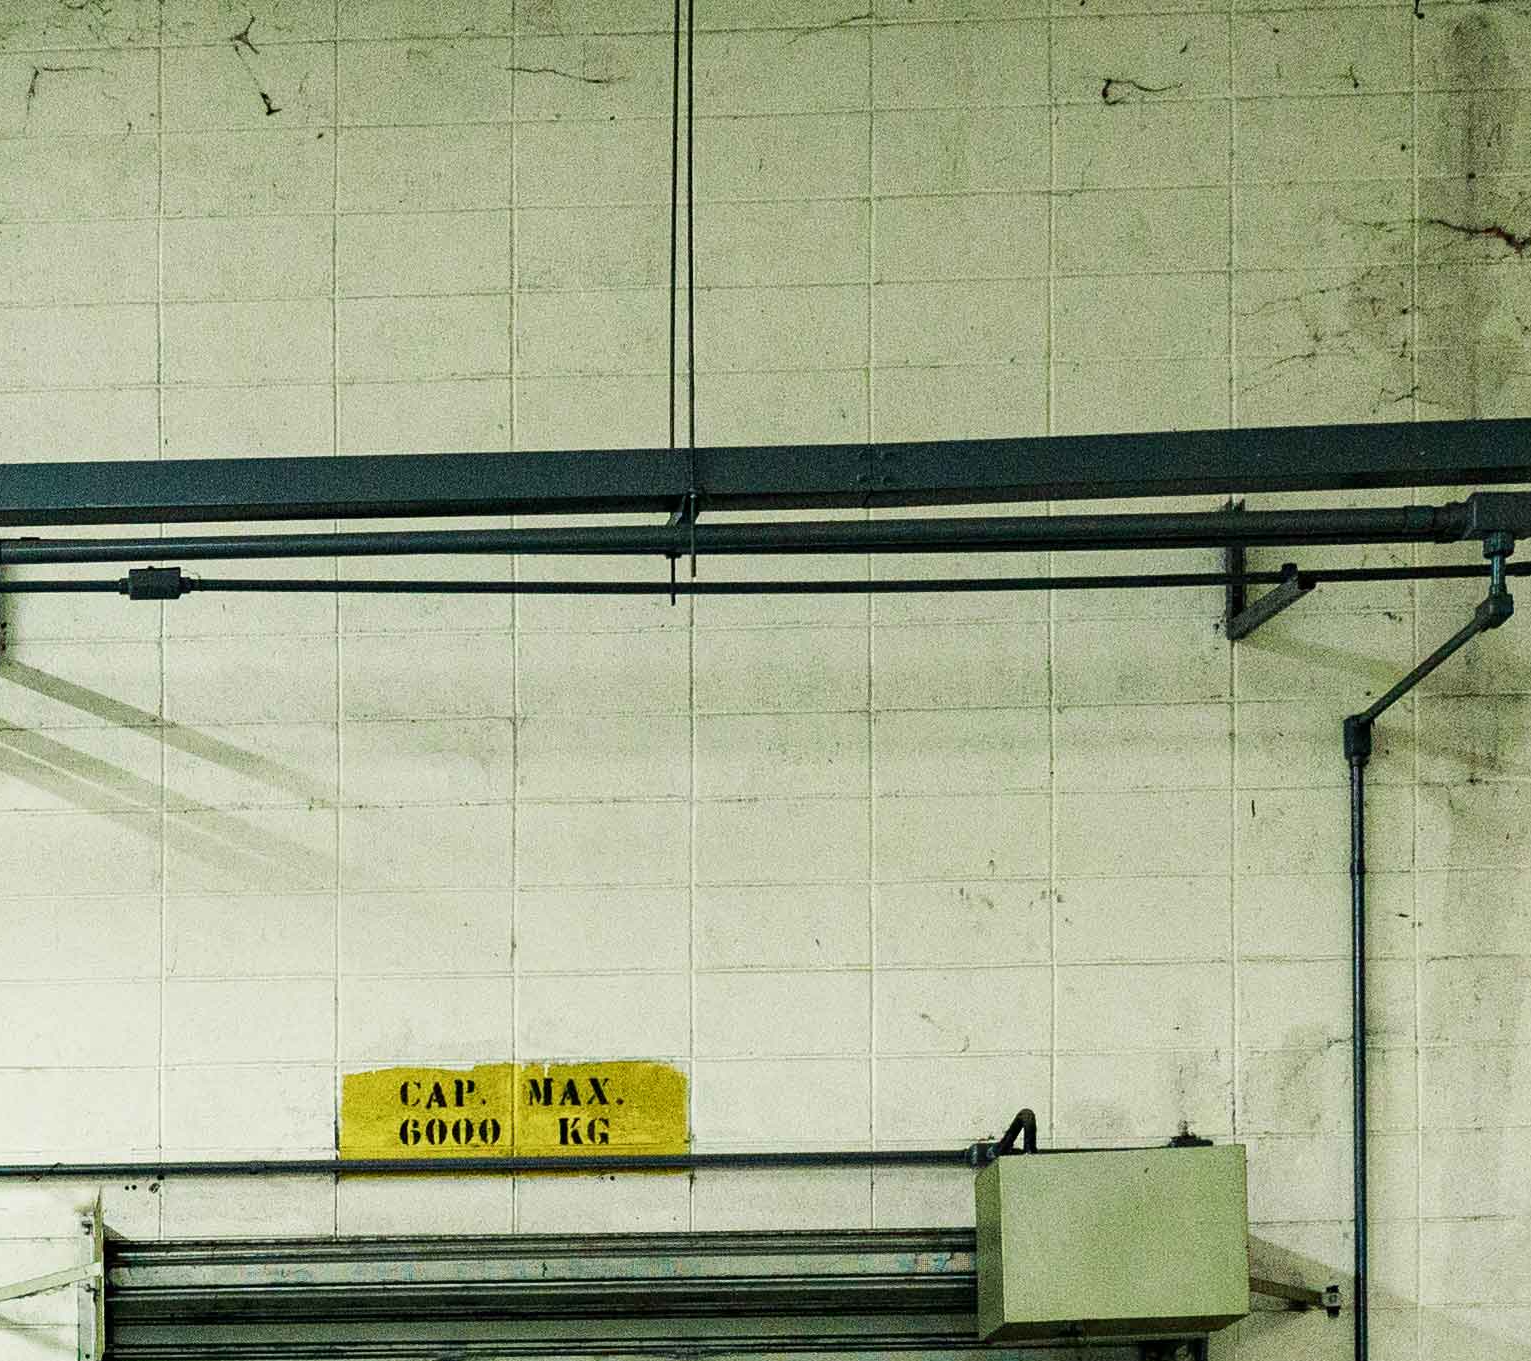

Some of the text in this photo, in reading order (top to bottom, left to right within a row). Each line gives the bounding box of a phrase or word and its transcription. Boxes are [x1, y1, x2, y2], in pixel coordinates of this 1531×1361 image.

[399, 1078, 626, 1108] CAP. MAX.
[399, 1117, 611, 1146] 6000 KG
